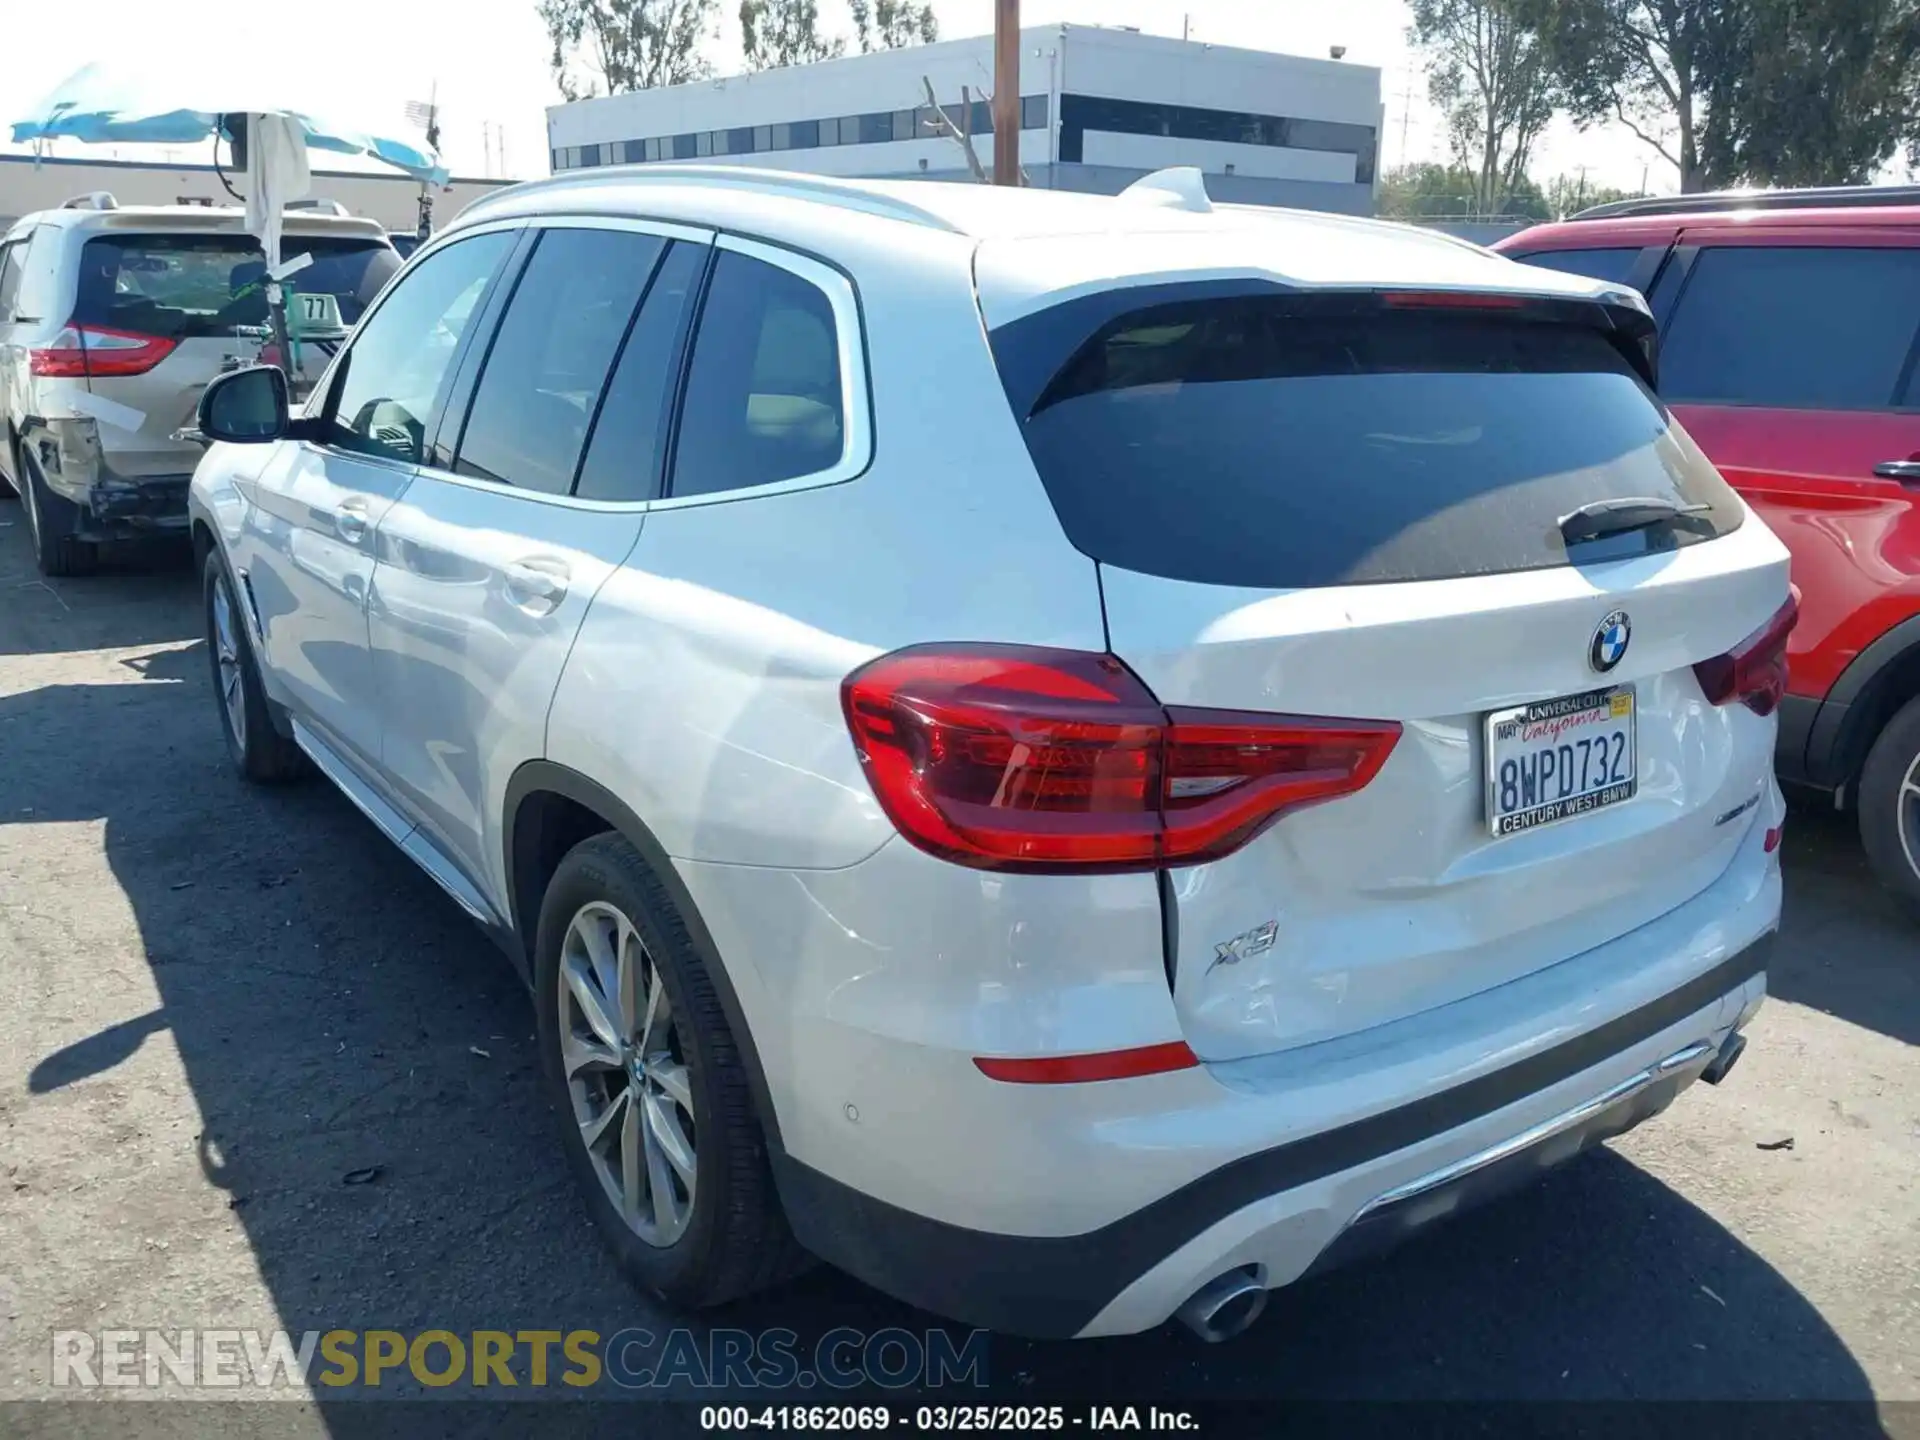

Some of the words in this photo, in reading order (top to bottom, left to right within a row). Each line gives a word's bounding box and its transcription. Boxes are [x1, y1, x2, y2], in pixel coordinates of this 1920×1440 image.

[304, 298, 325, 318] 77
[1520, 709, 1602, 743] California
[1529, 697, 1581, 721] UNIVERSAL
[1497, 725, 1517, 741] MAY
[1500, 731, 1626, 813] 8WPD732
[1503, 806, 1562, 832] CENTURY
[1566, 793, 1599, 815] WEST
[1602, 784, 1631, 804] BMW
[1205, 919, 1279, 976] X3
